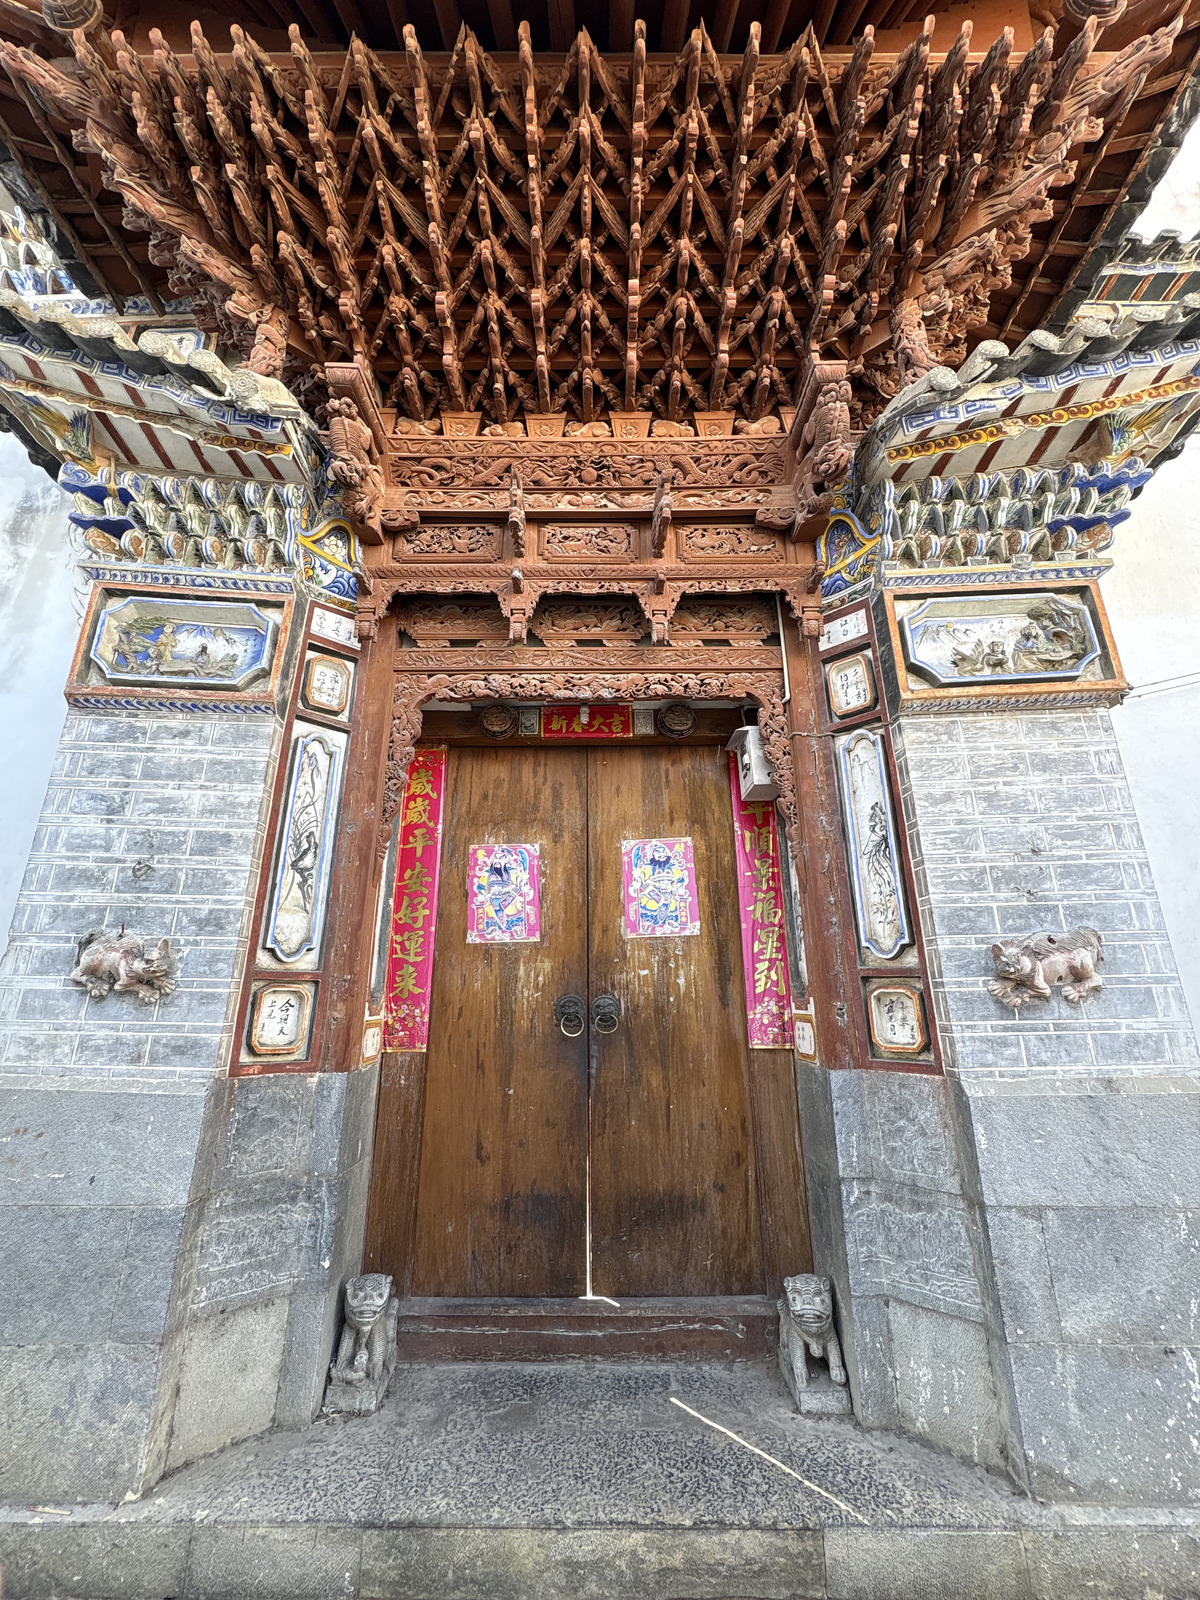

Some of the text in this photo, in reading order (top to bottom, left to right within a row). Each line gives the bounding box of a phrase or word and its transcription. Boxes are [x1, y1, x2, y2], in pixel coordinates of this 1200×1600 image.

[548, 713, 625, 734] 新春大吉
[740, 801, 786, 996] 年順景福星到
